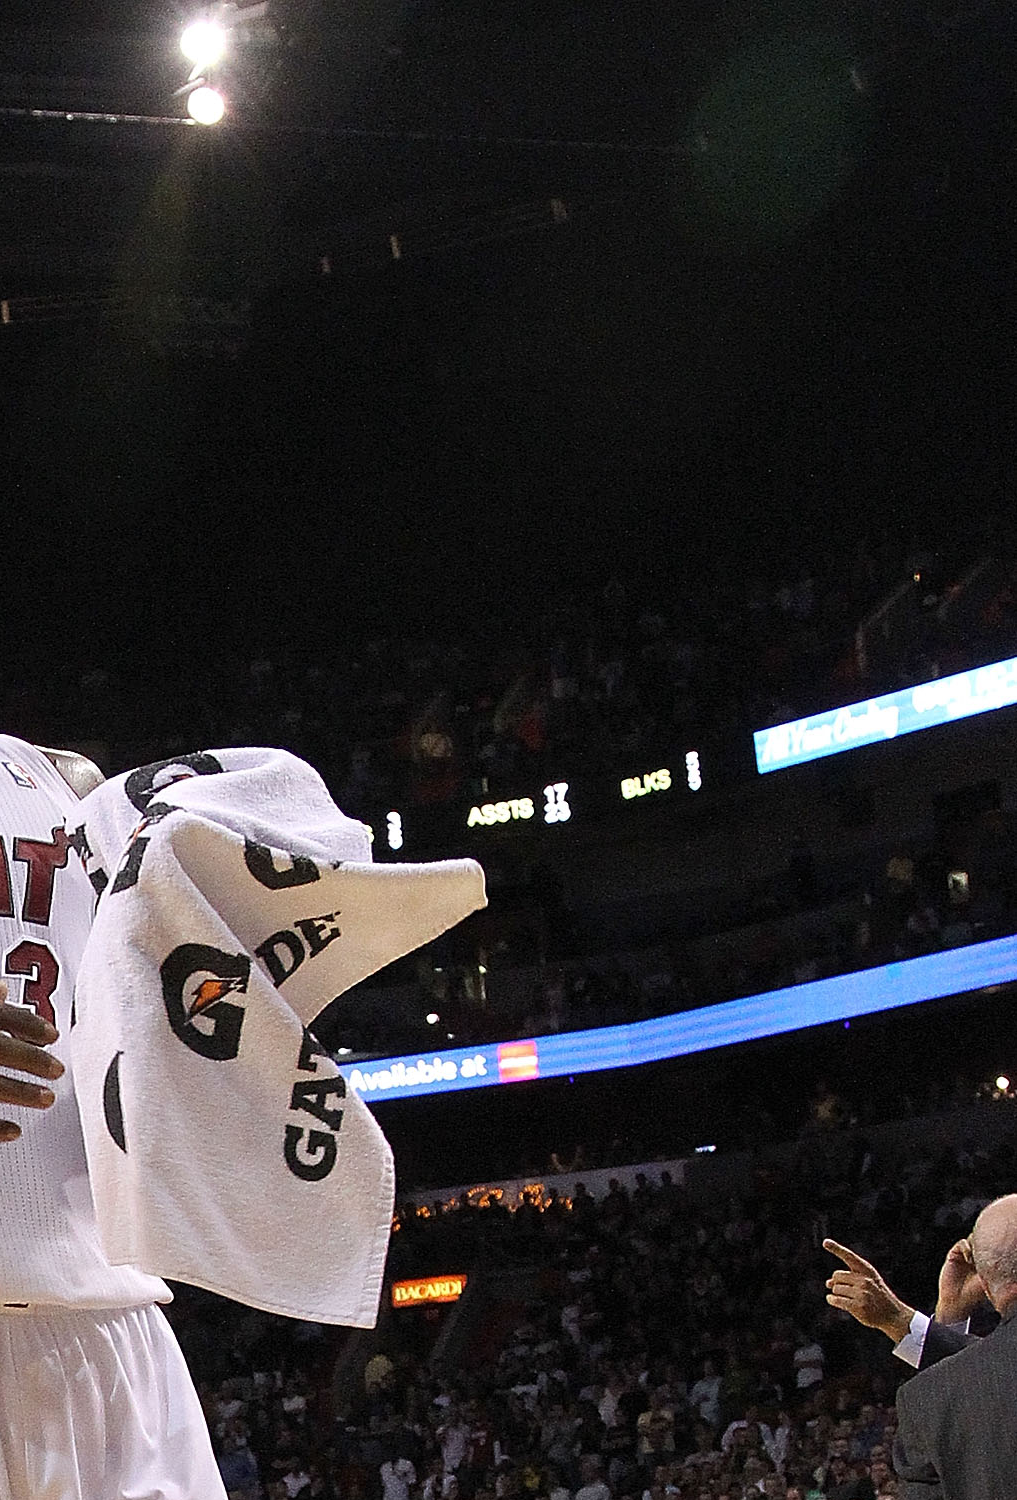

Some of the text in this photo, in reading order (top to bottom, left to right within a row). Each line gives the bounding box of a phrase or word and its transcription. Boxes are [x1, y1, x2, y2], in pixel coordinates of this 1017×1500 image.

[543, 782, 569, 803] 17
[620, 768, 672, 800] BLKS
[467, 797, 534, 828] ASSTS
[4, 940, 60, 1030] 3
[348, 1057, 458, 1092] Available
[460, 1053, 488, 1078] at
[395, 1280, 463, 1301] BACARDI
